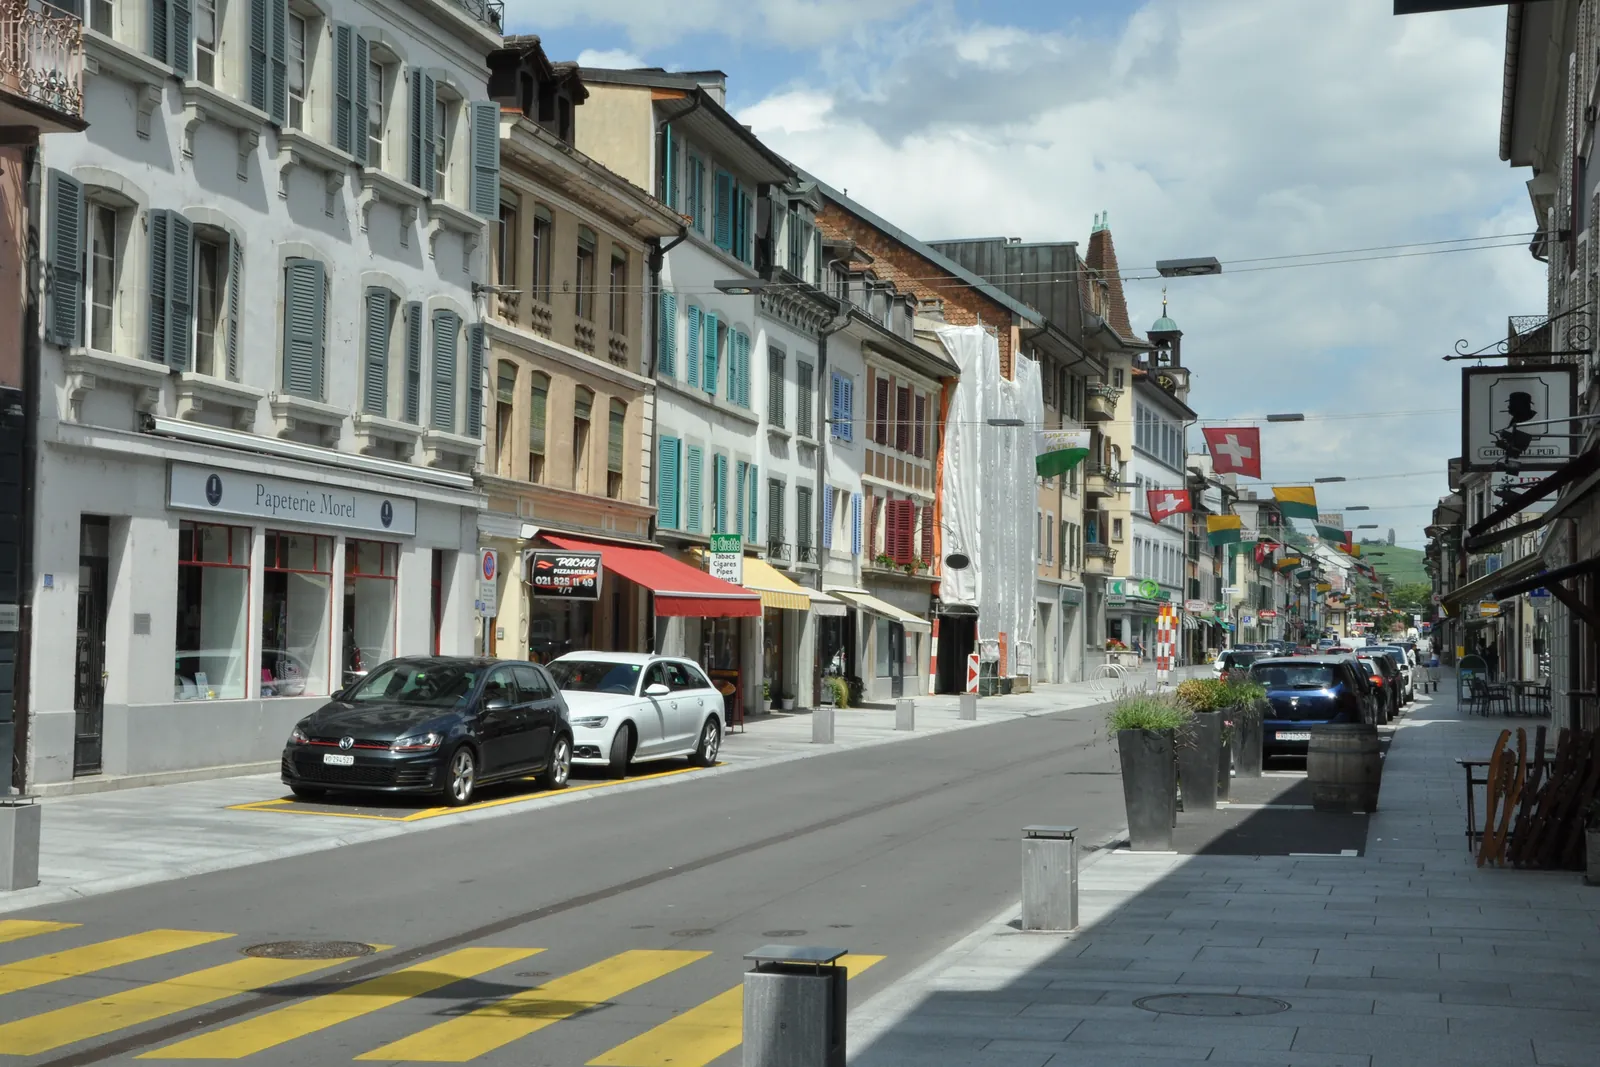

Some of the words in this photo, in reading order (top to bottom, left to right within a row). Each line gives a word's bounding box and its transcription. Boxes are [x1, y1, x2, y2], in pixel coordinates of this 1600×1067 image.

[1537, 448, 1555, 456] PUB
[256, 483, 316, 515] Papeterie
[320, 493, 356, 519] Morel
[712, 560, 737, 569] Cigares
[716, 568, 733, 576] Pipes
[535, 576, 551, 586] 021
[553, 577, 570, 586] 825
[573, 577, 580, 587] 11
[582, 578, 594, 588] 49
[558, 586, 573, 595] 7/7
